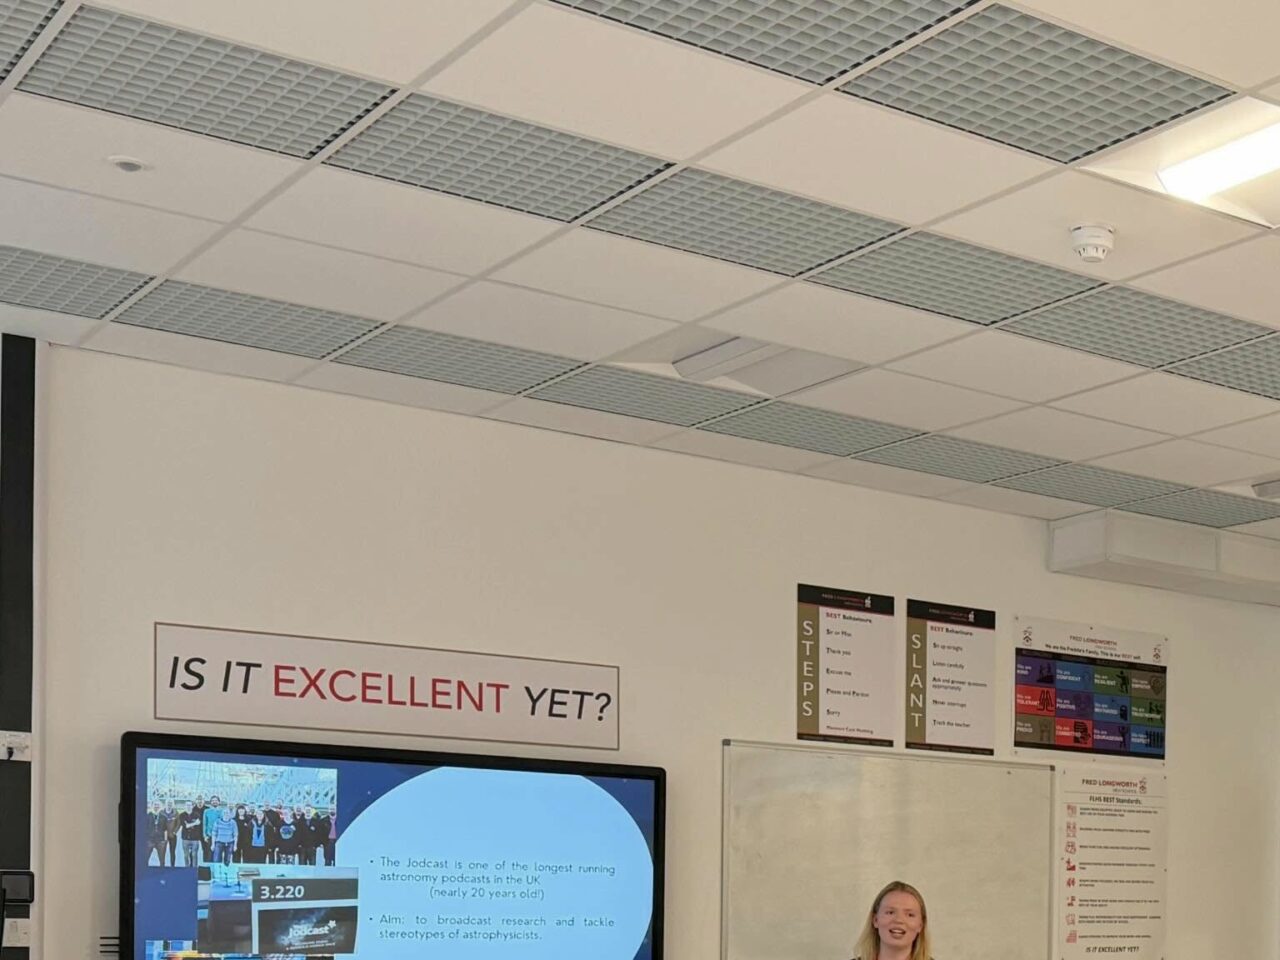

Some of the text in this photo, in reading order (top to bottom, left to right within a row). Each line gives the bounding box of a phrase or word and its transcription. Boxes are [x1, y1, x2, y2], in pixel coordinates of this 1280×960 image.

[802, 620, 815, 717] STEPS
[168, 655, 612, 721] IS IT EXCELLENT YET?
[910, 634, 923, 728] SLANT
[380, 856, 400, 868] The
[407, 858, 448, 869] Jodcast
[455, 860, 462, 870] is
[495, 860, 506, 870] of
[512, 862, 528, 870] the
[534, 862, 573, 874] longest
[579, 864, 616, 876] running
[380, 872, 541, 884] astronomy podcasts in the UK
[260, 885, 305, 900] 3.220
[430, 886, 468, 899] (nearly
[472, 888, 485, 898] 20
[488, 890, 516, 900] years
[416, 915, 428, 925] to
[437, 915, 492, 926] broadcast
[501, 916, 546, 926] research
[556, 917, 575, 926] and
[584, 917, 615, 928] tackle
[380, 929, 542, 941] stereotypes of astrophysicists.
